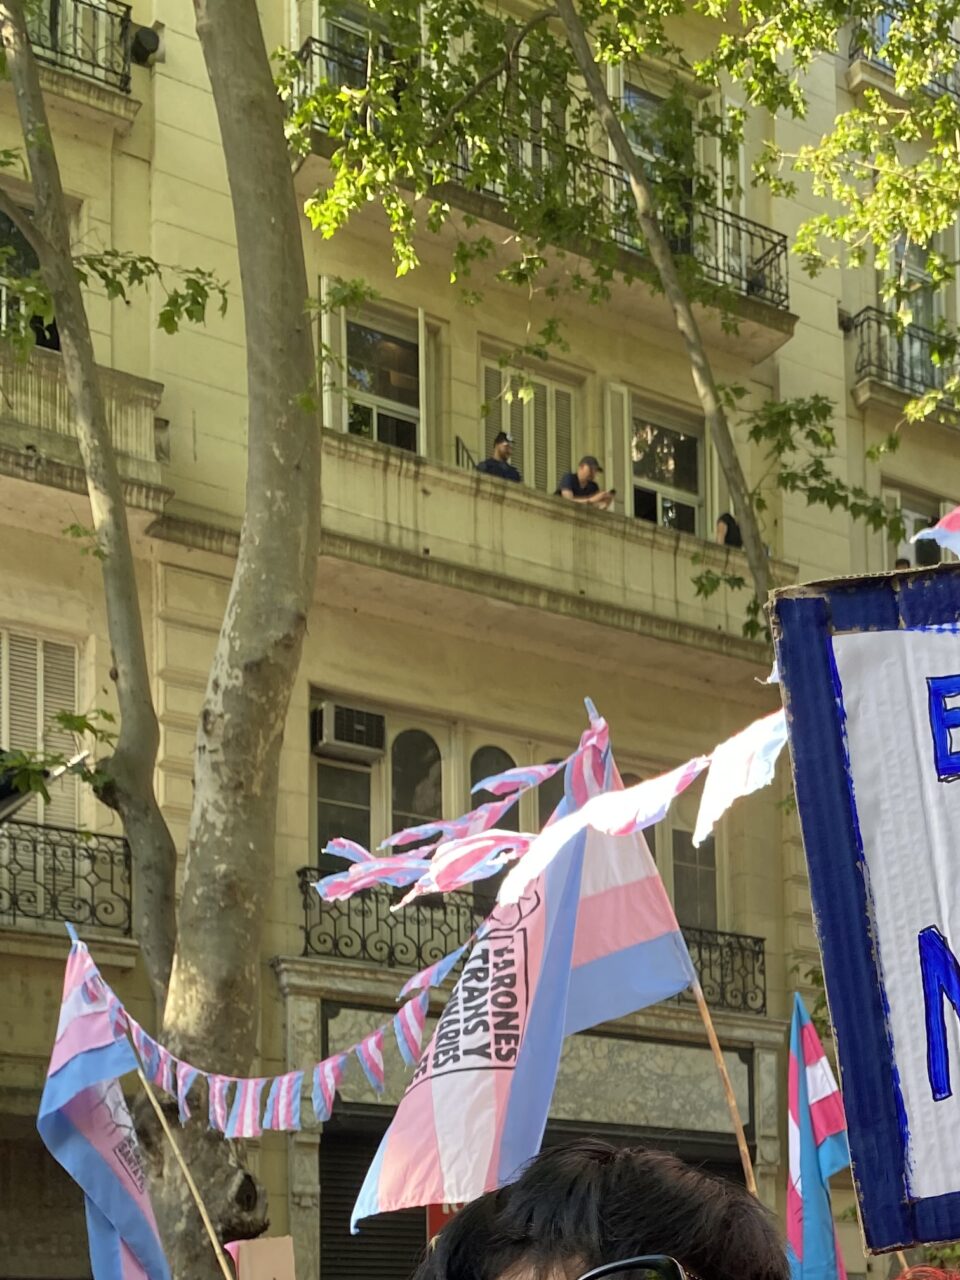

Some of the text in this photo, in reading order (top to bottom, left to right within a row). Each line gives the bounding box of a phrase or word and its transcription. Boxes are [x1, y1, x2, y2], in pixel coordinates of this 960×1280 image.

[433, 987, 461, 1069] NARIES
[463, 949, 492, 1061] TRANS Y
